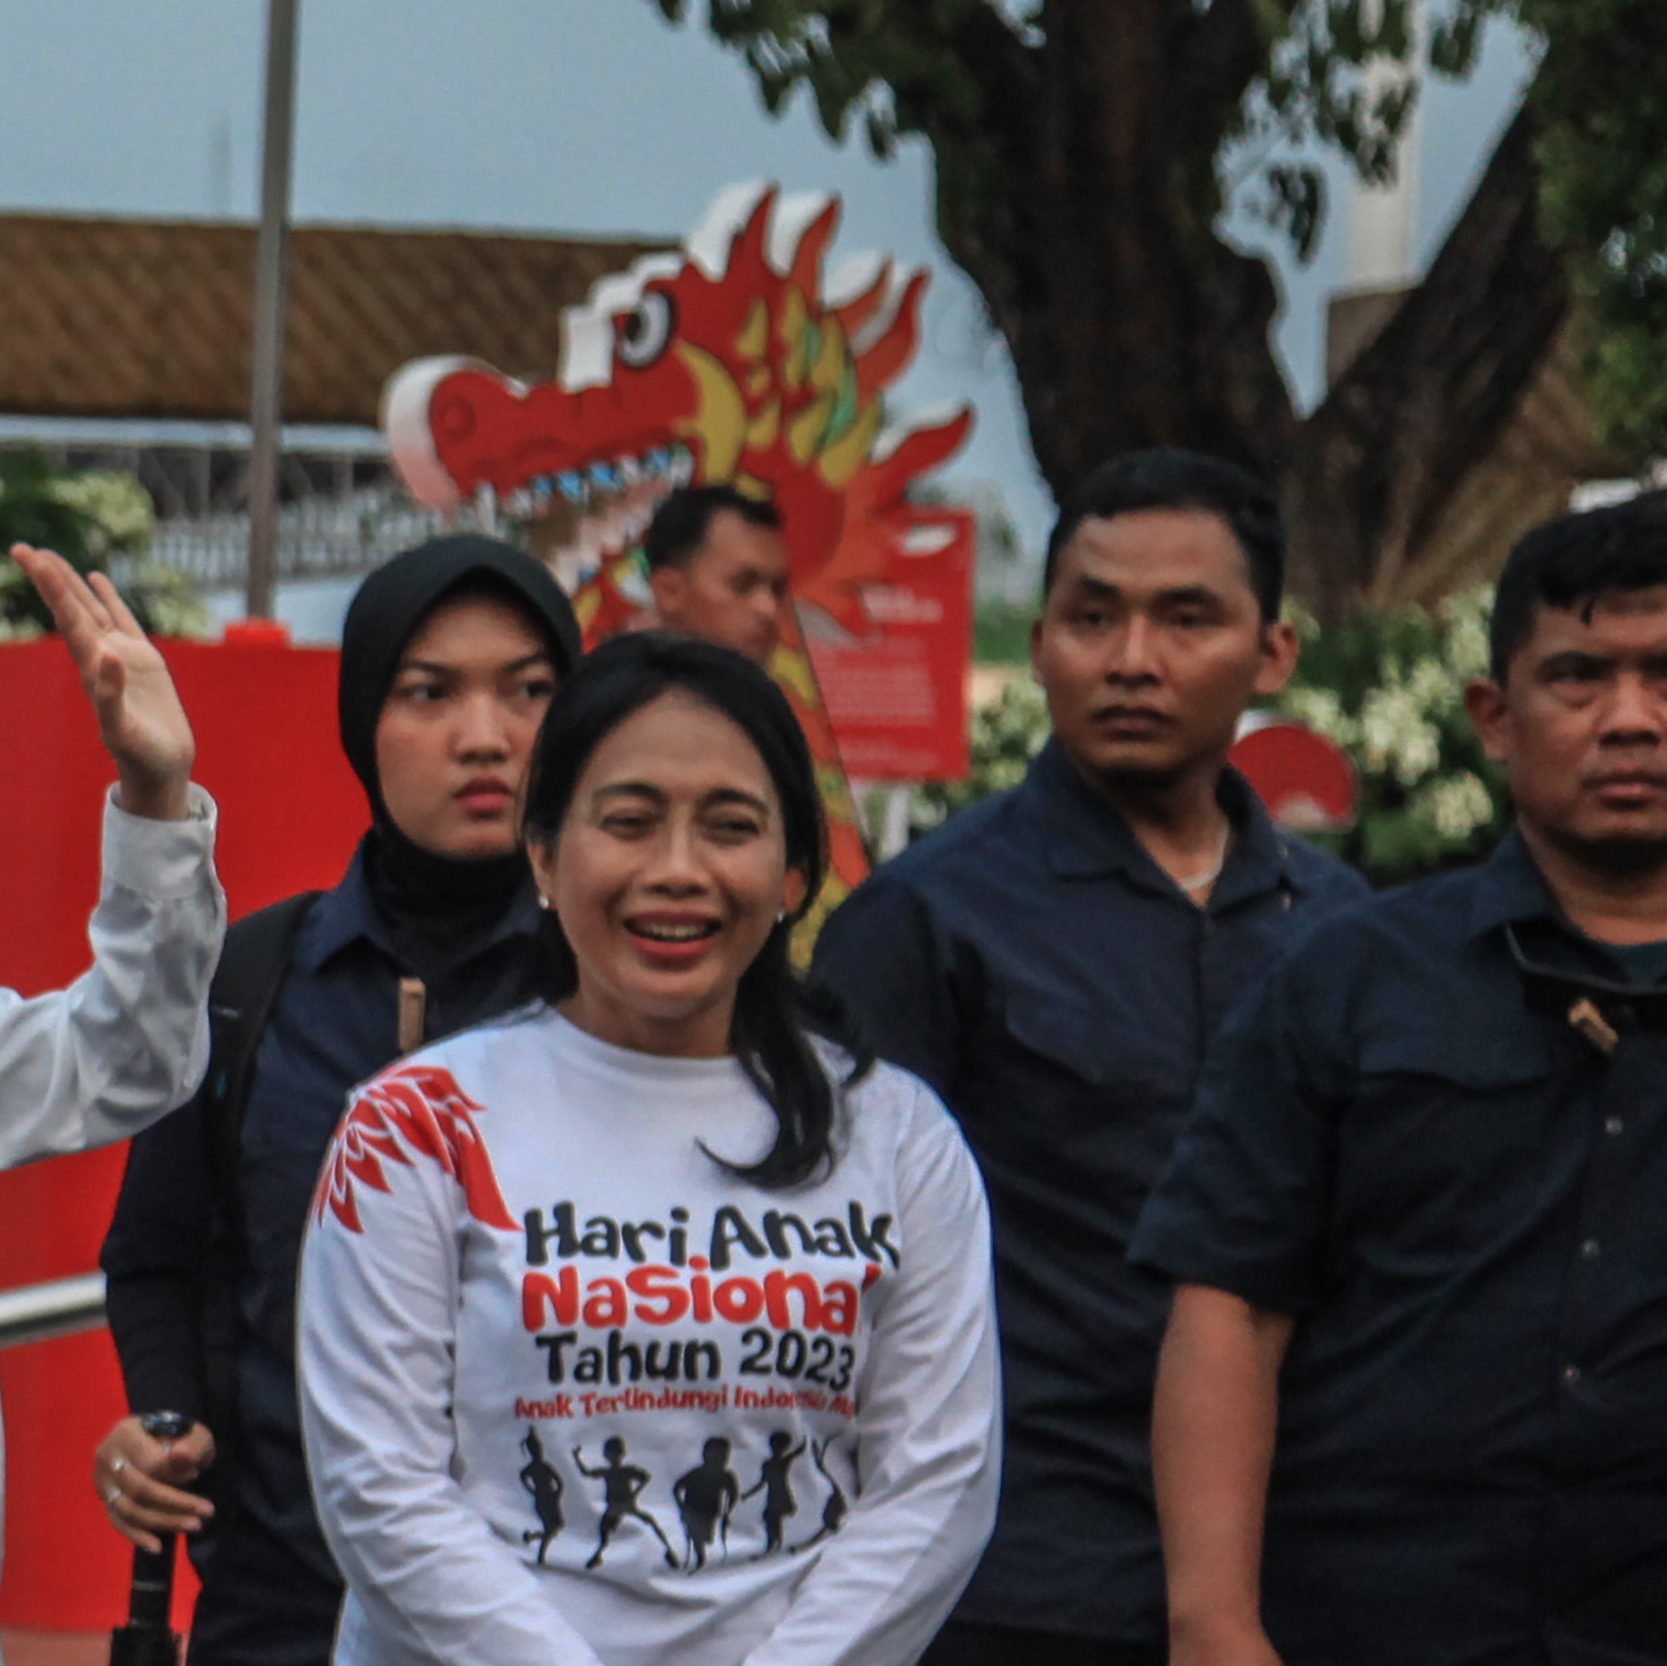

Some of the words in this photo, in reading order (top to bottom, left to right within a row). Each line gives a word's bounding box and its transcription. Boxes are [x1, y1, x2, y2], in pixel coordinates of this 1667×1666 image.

[523, 1202, 690, 1268] Hari
[709, 1199, 901, 1272] Anak
[535, 1332, 722, 1386] Tahun
[739, 1326, 856, 1392] 2023
[515, 1393, 574, 1420] Anak
[578, 1384, 729, 1418] Terlindungi
